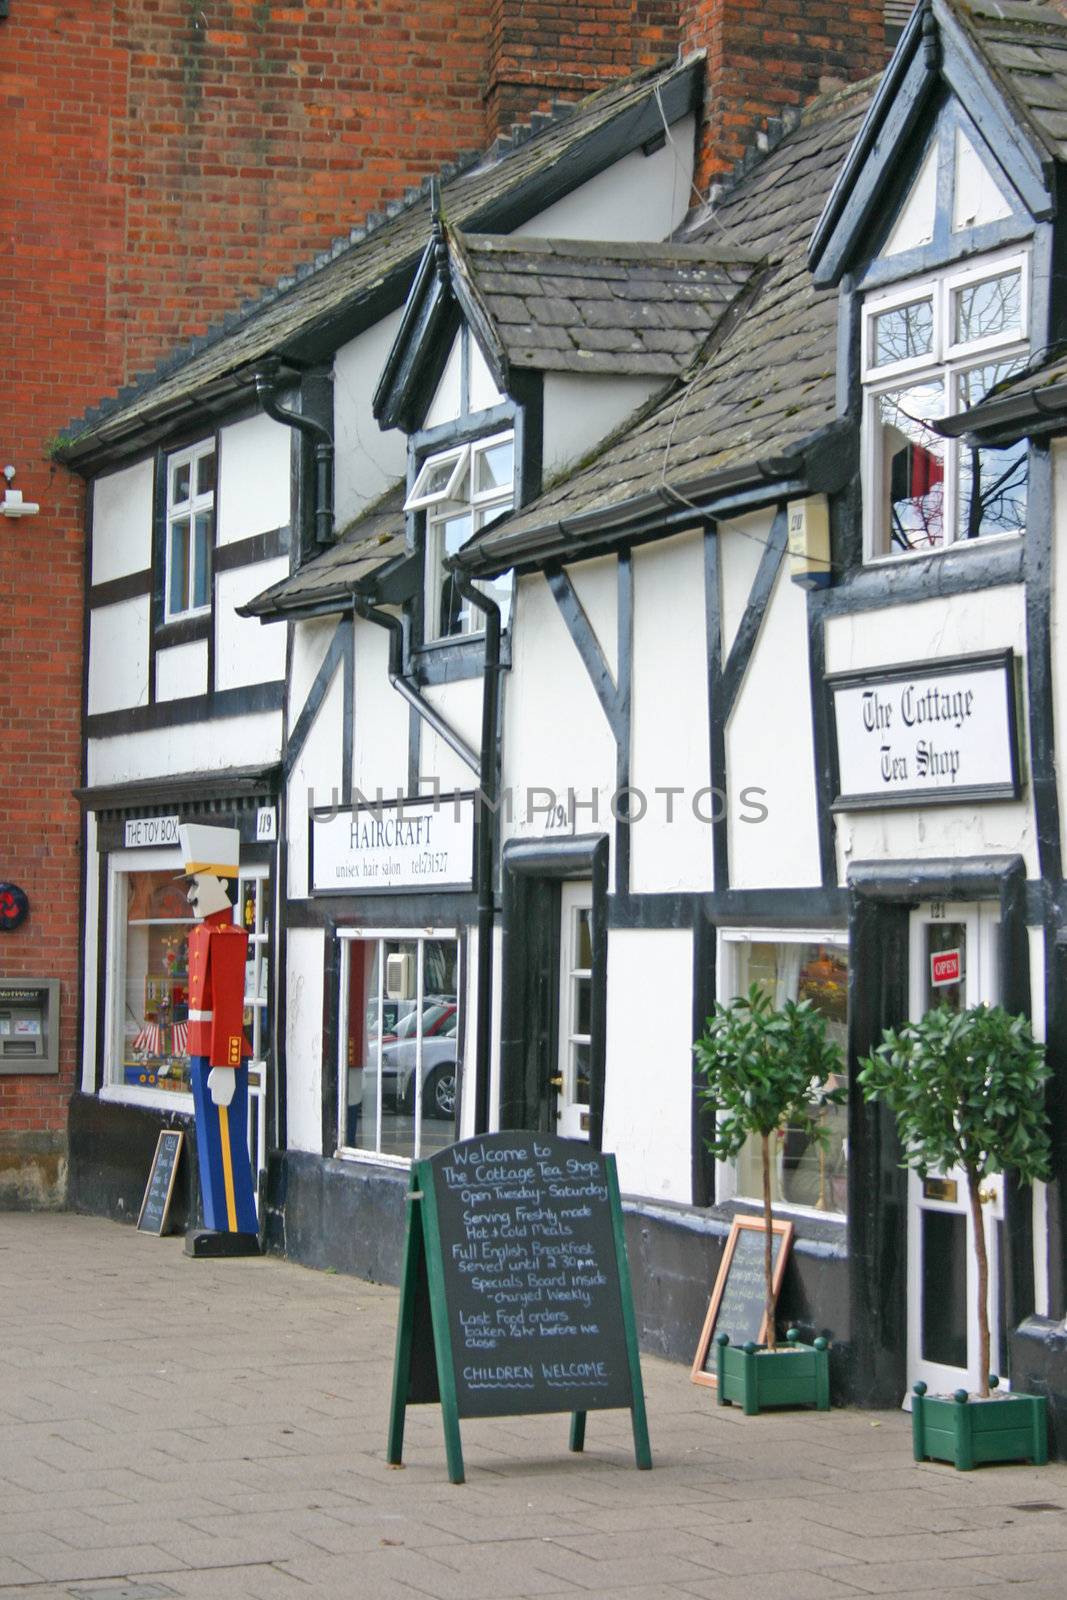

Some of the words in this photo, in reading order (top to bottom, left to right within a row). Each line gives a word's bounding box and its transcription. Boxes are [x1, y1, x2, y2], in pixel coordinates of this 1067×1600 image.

[862, 692, 893, 733] The
[901, 684, 973, 729] Cottage
[880, 745, 908, 783] Tea
[916, 740, 960, 784] Shop
[127, 822, 142, 844] THE
[144, 820, 160, 842] TOY
[161, 819, 178, 841] BOX
[259, 813, 272, 834] 119
[350, 815, 433, 849] HAIRCRAFT
[335, 859, 360, 878] unisex
[362, 857, 379, 877] hair
[382, 856, 401, 876] salon
[935, 960, 957, 975] OPEN
[453, 1144, 528, 1165] Welcome
[533, 1142, 552, 1158] to
[442, 1166, 467, 1184] The
[475, 1165, 535, 1185] Cottage
[537, 1161, 563, 1177] Tea
[566, 1158, 599, 1177] Shop
[460, 1189, 492, 1208] Open
[549, 1181, 609, 1201] Saturday
[463, 1210, 511, 1227] Serving
[515, 1206, 558, 1225] Freshly
[560, 1205, 593, 1218] made
[466, 1226, 490, 1240] Hot
[500, 1225, 527, 1238] Cold
[452, 1243, 477, 1260] Full
[482, 1241, 528, 1263] English
[531, 1240, 595, 1256] Breakfast
[508, 1256, 540, 1271] until
[471, 1275, 524, 1293] Specials
[527, 1271, 566, 1288] Board
[571, 1269, 608, 1287] inside
[459, 1310, 491, 1326] Last
[496, 1308, 525, 1325] Food
[528, 1307, 570, 1324] orders
[540, 1322, 578, 1336] before
[580, 1322, 600, 1334] we
[463, 1365, 535, 1381] CHILDREN
[541, 1361, 608, 1379] WELCOME
